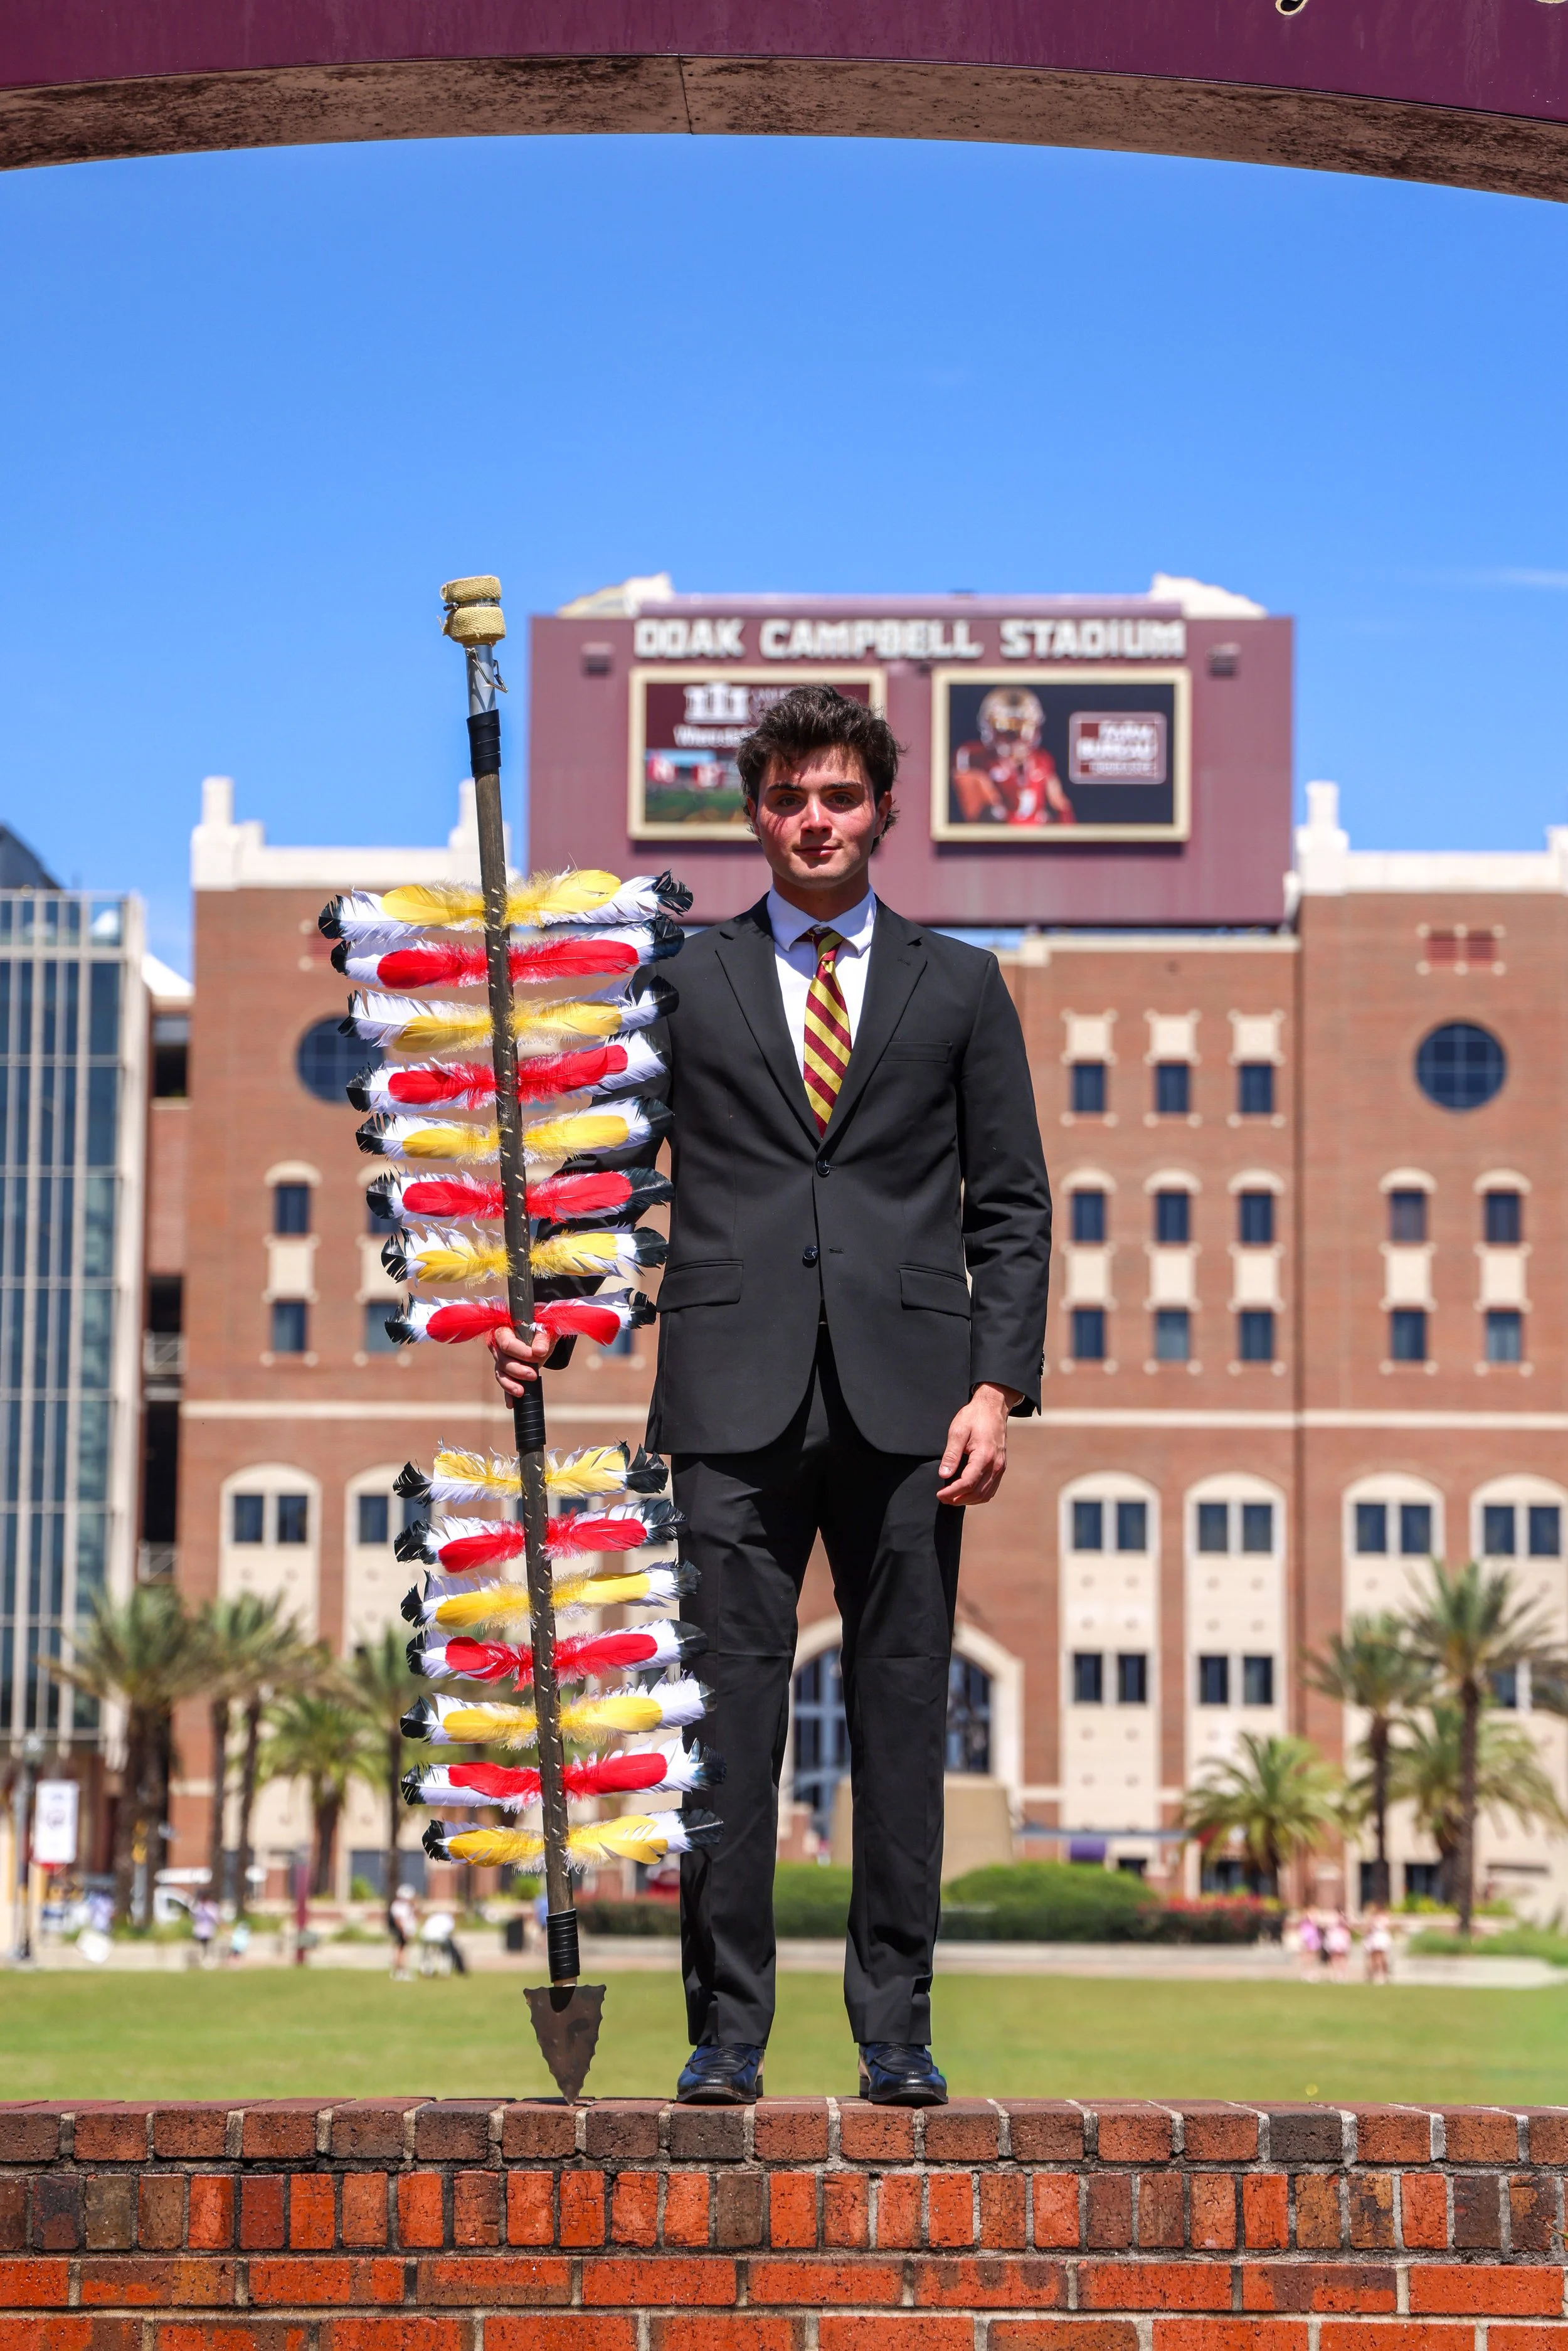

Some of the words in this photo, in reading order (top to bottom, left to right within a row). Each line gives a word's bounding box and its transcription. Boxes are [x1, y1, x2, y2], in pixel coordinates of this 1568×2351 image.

[634, 618, 744, 658] DOAK
[759, 618, 984, 659] CAMPBELL
[1000, 618, 1187, 659] STADIUM
